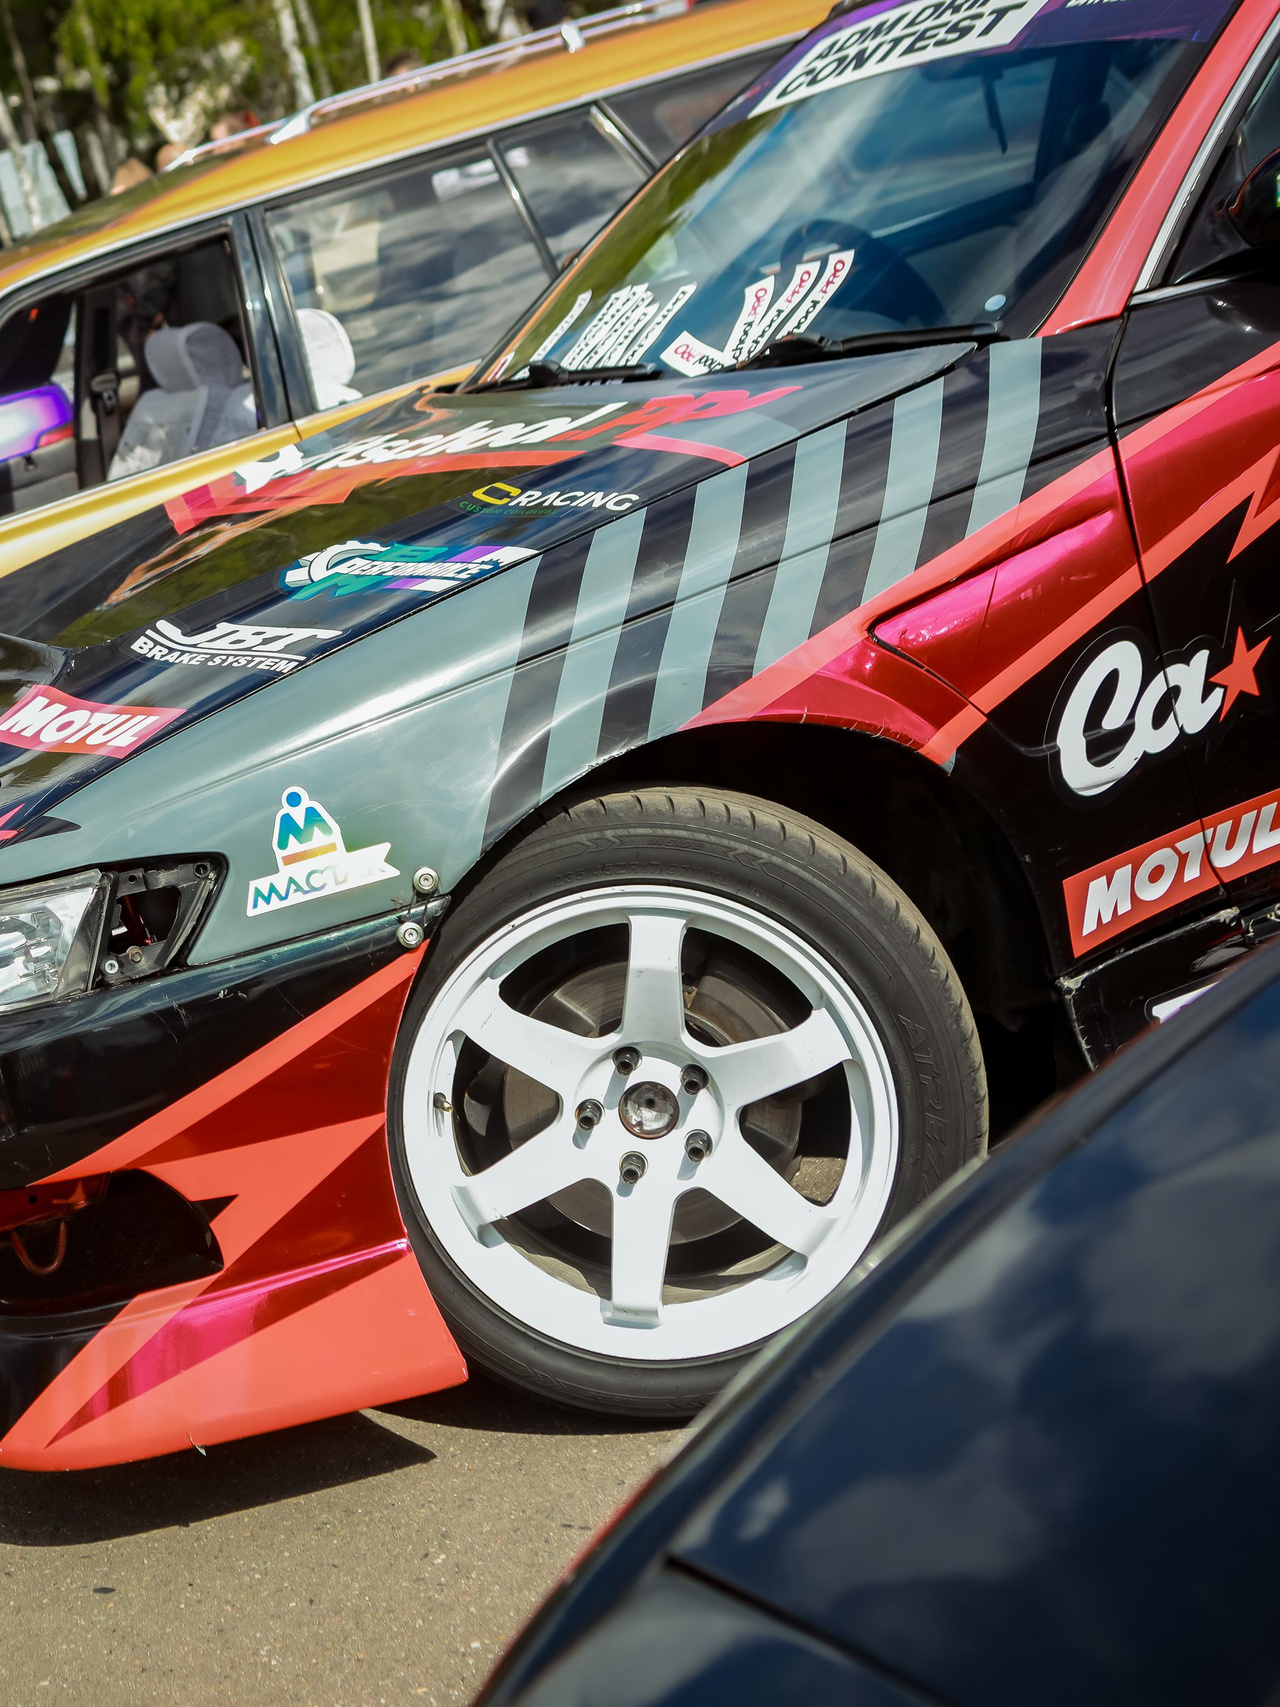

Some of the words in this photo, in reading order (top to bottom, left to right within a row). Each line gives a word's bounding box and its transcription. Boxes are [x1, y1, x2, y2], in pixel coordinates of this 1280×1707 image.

[776, 2, 1027, 99] CONTEST
[805, 10, 910, 67] ADM
[508, 490, 640, 512] RACING
[130, 635, 209, 666] BRAKE
[207, 655, 299, 673] SYSTEM
[1082, 801, 1280, 938] MOTUL
